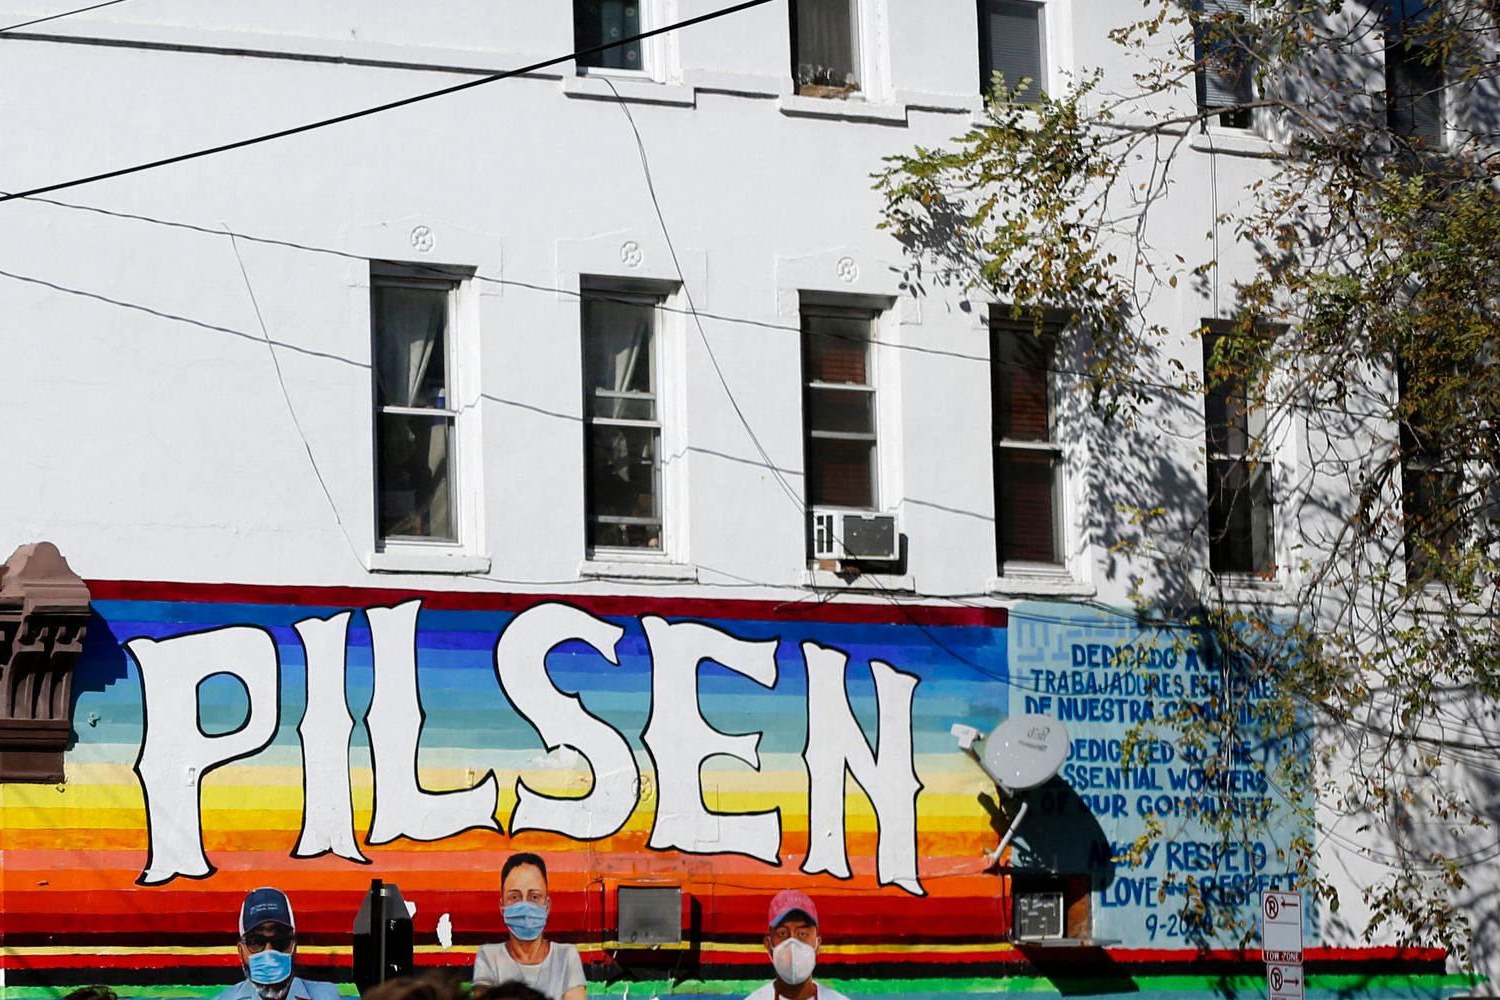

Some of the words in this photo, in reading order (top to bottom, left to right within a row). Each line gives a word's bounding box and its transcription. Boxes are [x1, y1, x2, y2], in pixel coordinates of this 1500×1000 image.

[1185, 648, 1199, 672] A
[1030, 669, 1184, 698] TRABAJADORES
[1058, 696, 1155, 723] NUESTRA
[124, 599, 925, 896] PILSEN
[1066, 739, 1175, 765] EDICTED
[1061, 763, 1164, 791] SSENTIAL
[1079, 794, 1128, 818] OUR
[1100, 877, 1157, 908] LOVE
